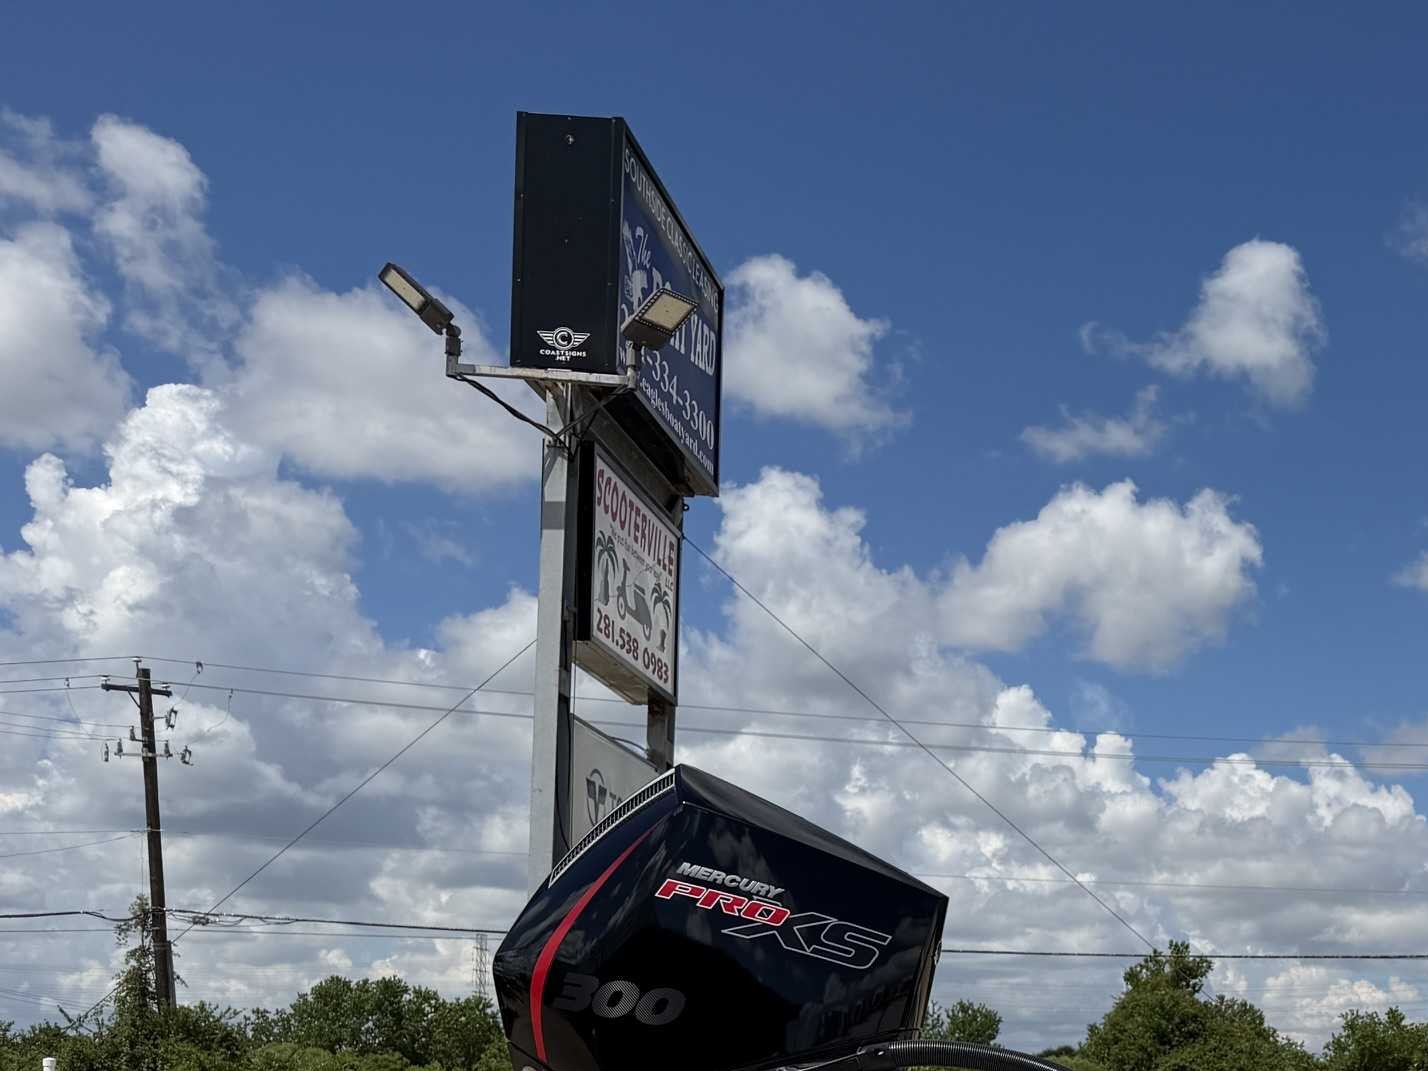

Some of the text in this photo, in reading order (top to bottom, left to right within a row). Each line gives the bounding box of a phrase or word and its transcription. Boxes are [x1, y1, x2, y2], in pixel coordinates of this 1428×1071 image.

[624, 148, 719, 312] SOUTHSIDE CLASSIC LEASING
[635, 226, 652, 269] The
[539, 349, 587, 357] COASTSIGNS
[689, 314, 717, 376] YARD
[596, 468, 675, 576] SCOOTERVILLE
[596, 607, 670, 684] 281.538 0983
[676, 862, 785, 898] MERCURY
[654, 878, 893, 970] PRO XS
[551, 972, 688, 1027] 300
